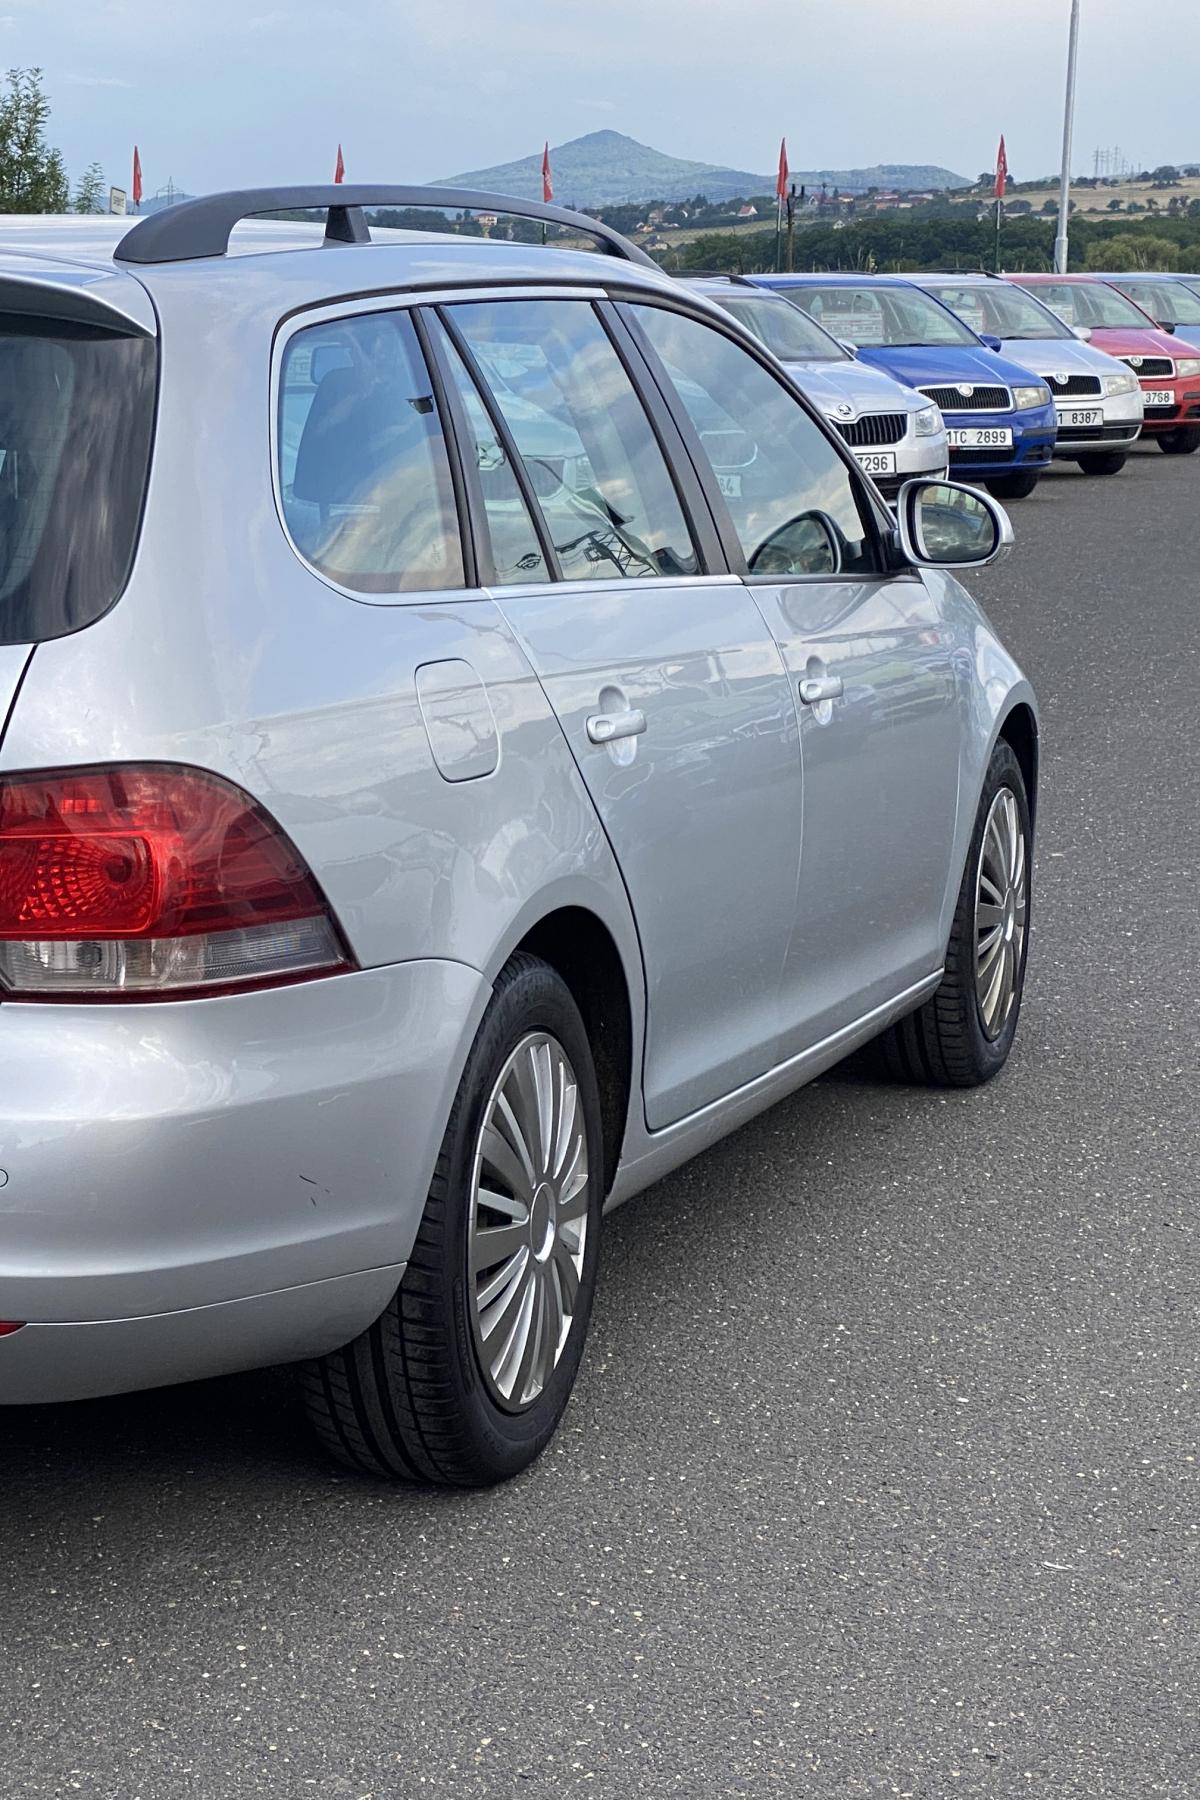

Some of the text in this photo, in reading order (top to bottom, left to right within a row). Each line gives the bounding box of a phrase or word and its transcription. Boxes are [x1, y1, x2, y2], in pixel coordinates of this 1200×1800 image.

[1071, 412, 1098, 424] 8387
[946, 430, 1006, 444] 1TC 2899
